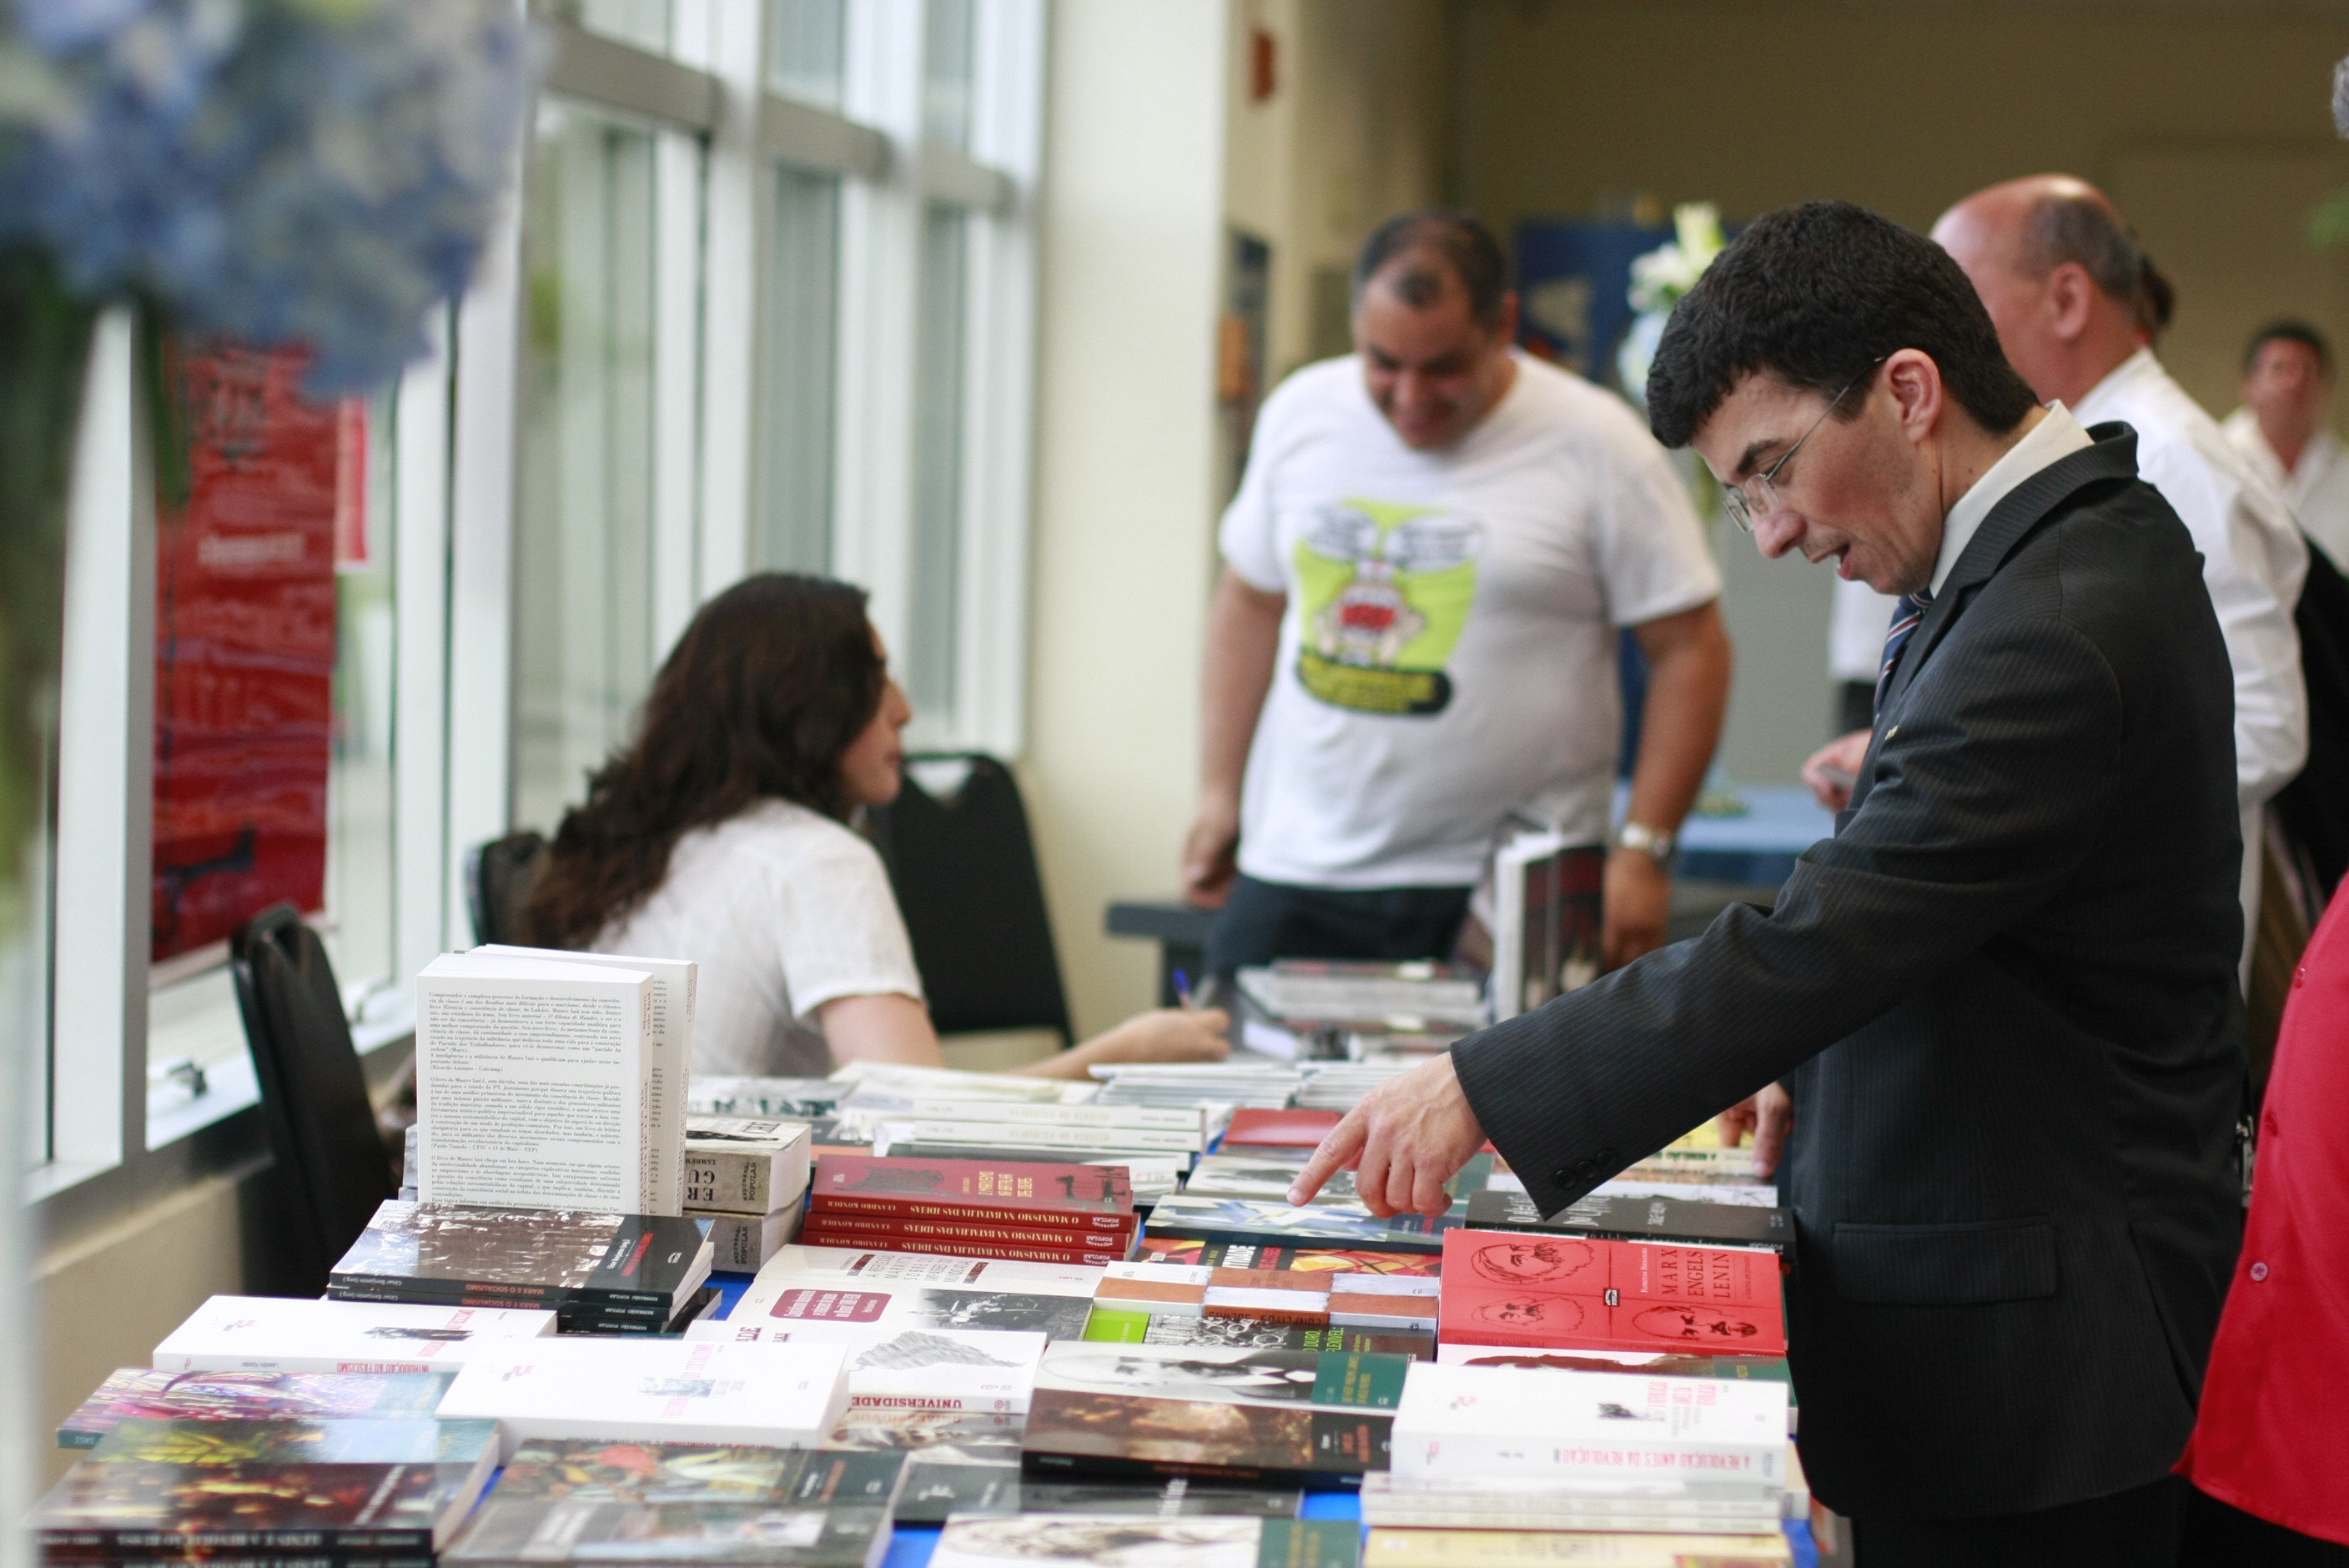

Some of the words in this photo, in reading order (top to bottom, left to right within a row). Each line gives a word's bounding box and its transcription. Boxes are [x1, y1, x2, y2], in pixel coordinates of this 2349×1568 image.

[749, 1163, 757, 1201] POPULAR
[861, 1203, 897, 1211] LEANDRO
[910, 1206, 940, 1214] IDEIAS
[943, 1208, 960, 1216] DAS
[962, 1209, 1001, 1219] BATALHA
[1003, 1211, 1015, 1219] NA
[1018, 1213, 1069, 1224] MARXISMO
[854, 1221, 890, 1230] LEANDRO
[903, 1224, 934, 1233] IDEIAS
[936, 1226, 953, 1234] DAS
[955, 1227, 995, 1238] BATALHA
[998, 1230, 1009, 1239] NA
[1011, 1232, 1062, 1243] MARXISMO
[741, 1226, 749, 1264] POPULAR
[853, 1239, 888, 1248] LEANDRO
[902, 1242, 932, 1251] IDEIAS
[933, 1244, 951, 1253] DAS
[953, 1245, 993, 1256] BATALHA
[995, 1249, 1006, 1257] NA
[1009, 1249, 1059, 1260] MARXISMO
[1661, 1249, 1678, 1295] MARX
[1687, 1250, 1704, 1297] ENGELS
[1713, 1253, 1731, 1299] LENIN
[343, 1276, 359, 1285] (org.)
[360, 1278, 385, 1287] Benjamin
[386, 1279, 402, 1287] César
[465, 1284, 509, 1294] SOCIALISMO
[355, 1292, 382, 1300] Benjamin
[382, 1293, 399, 1301] César
[461, 1299, 505, 1308] SOCIALISMO
[336, 1363, 372, 1372] FASCISMO
[852, 1396, 962, 1410] UNIVERSIDADE
